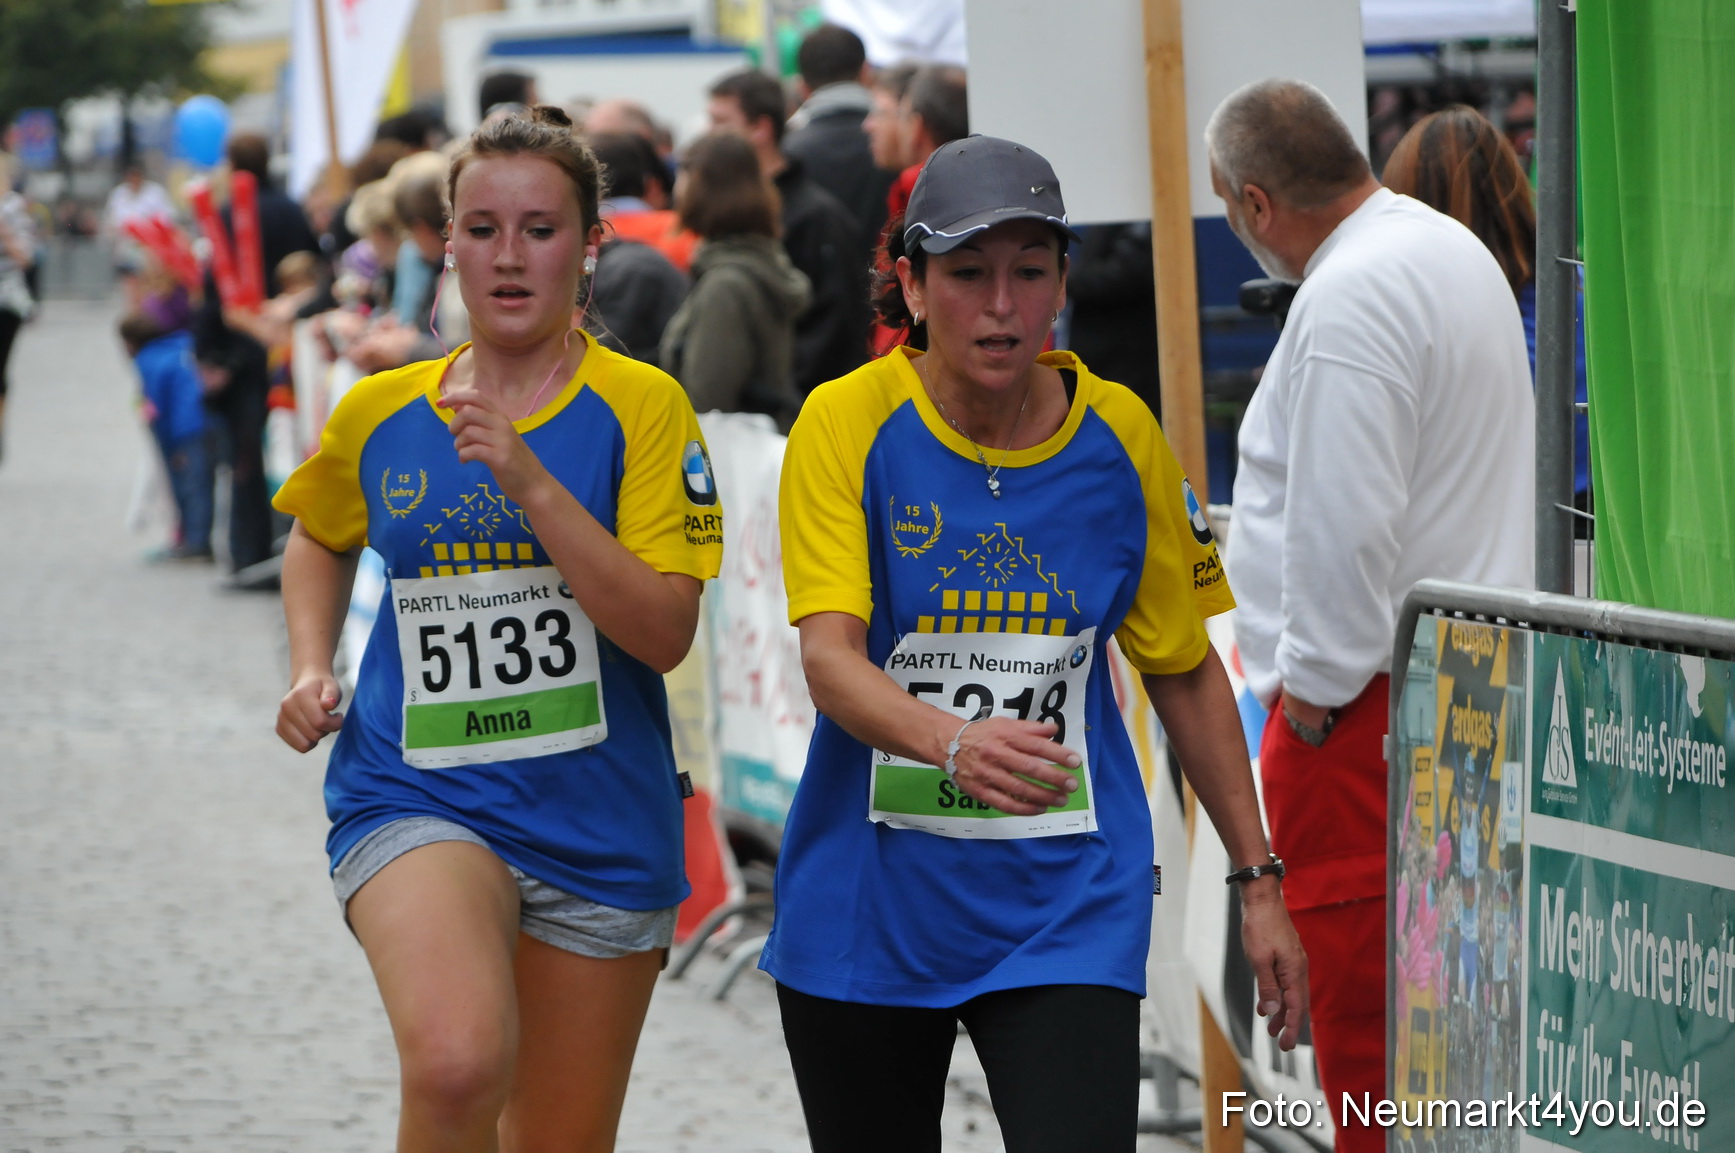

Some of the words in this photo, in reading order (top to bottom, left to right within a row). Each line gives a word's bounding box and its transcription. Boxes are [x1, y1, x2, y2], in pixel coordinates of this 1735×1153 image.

[389, 488, 415, 497] Jahre
[398, 474, 410, 483] 15
[905, 505, 920, 517] 15
[895, 520, 929, 535] Jahre
[399, 595, 455, 615] PARTL
[459, 585, 550, 611] Neumarkt
[419, 608, 577, 694] 5133
[890, 652, 963, 670] PARTL
[969, 653, 1066, 676] Neumarkt
[465, 708, 532, 737] Anna
[907, 680, 1067, 746] 218
[1452, 694, 1493, 760] erdgas
[1585, 706, 1727, 794] Event-Leit-Systeme
[1539, 884, 1604, 984] Mehr
[1610, 900, 1735, 1023] Sicherheit
[1537, 1008, 1576, 1113] für
[1581, 1023, 1612, 1122] Ihr
[1620, 1039, 1700, 1152] Event!
